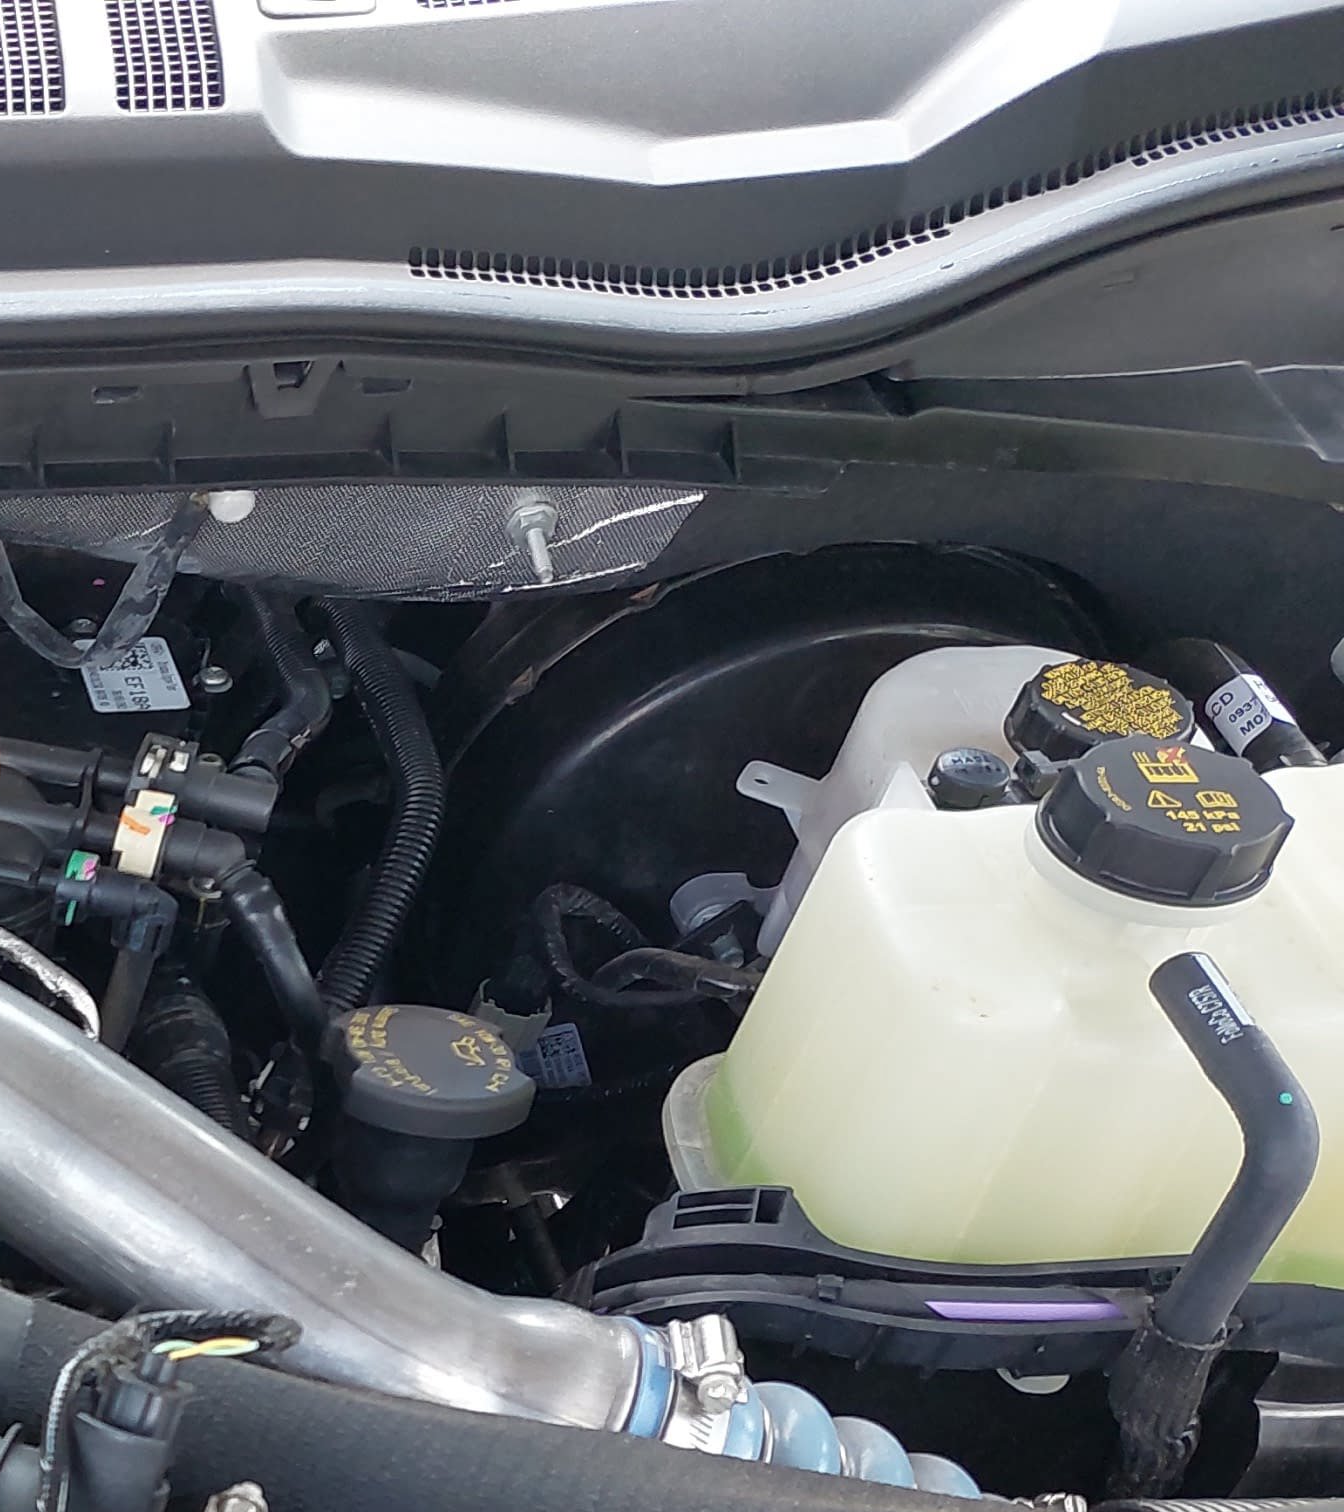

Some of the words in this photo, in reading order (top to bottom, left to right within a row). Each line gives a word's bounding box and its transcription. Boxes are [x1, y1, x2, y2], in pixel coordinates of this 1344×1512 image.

[1165, 810, 1201, 821] 145
[1202, 810, 1240, 820] kPa
[1182, 822, 1208, 832] 21
[1210, 822, 1241, 833] psi
